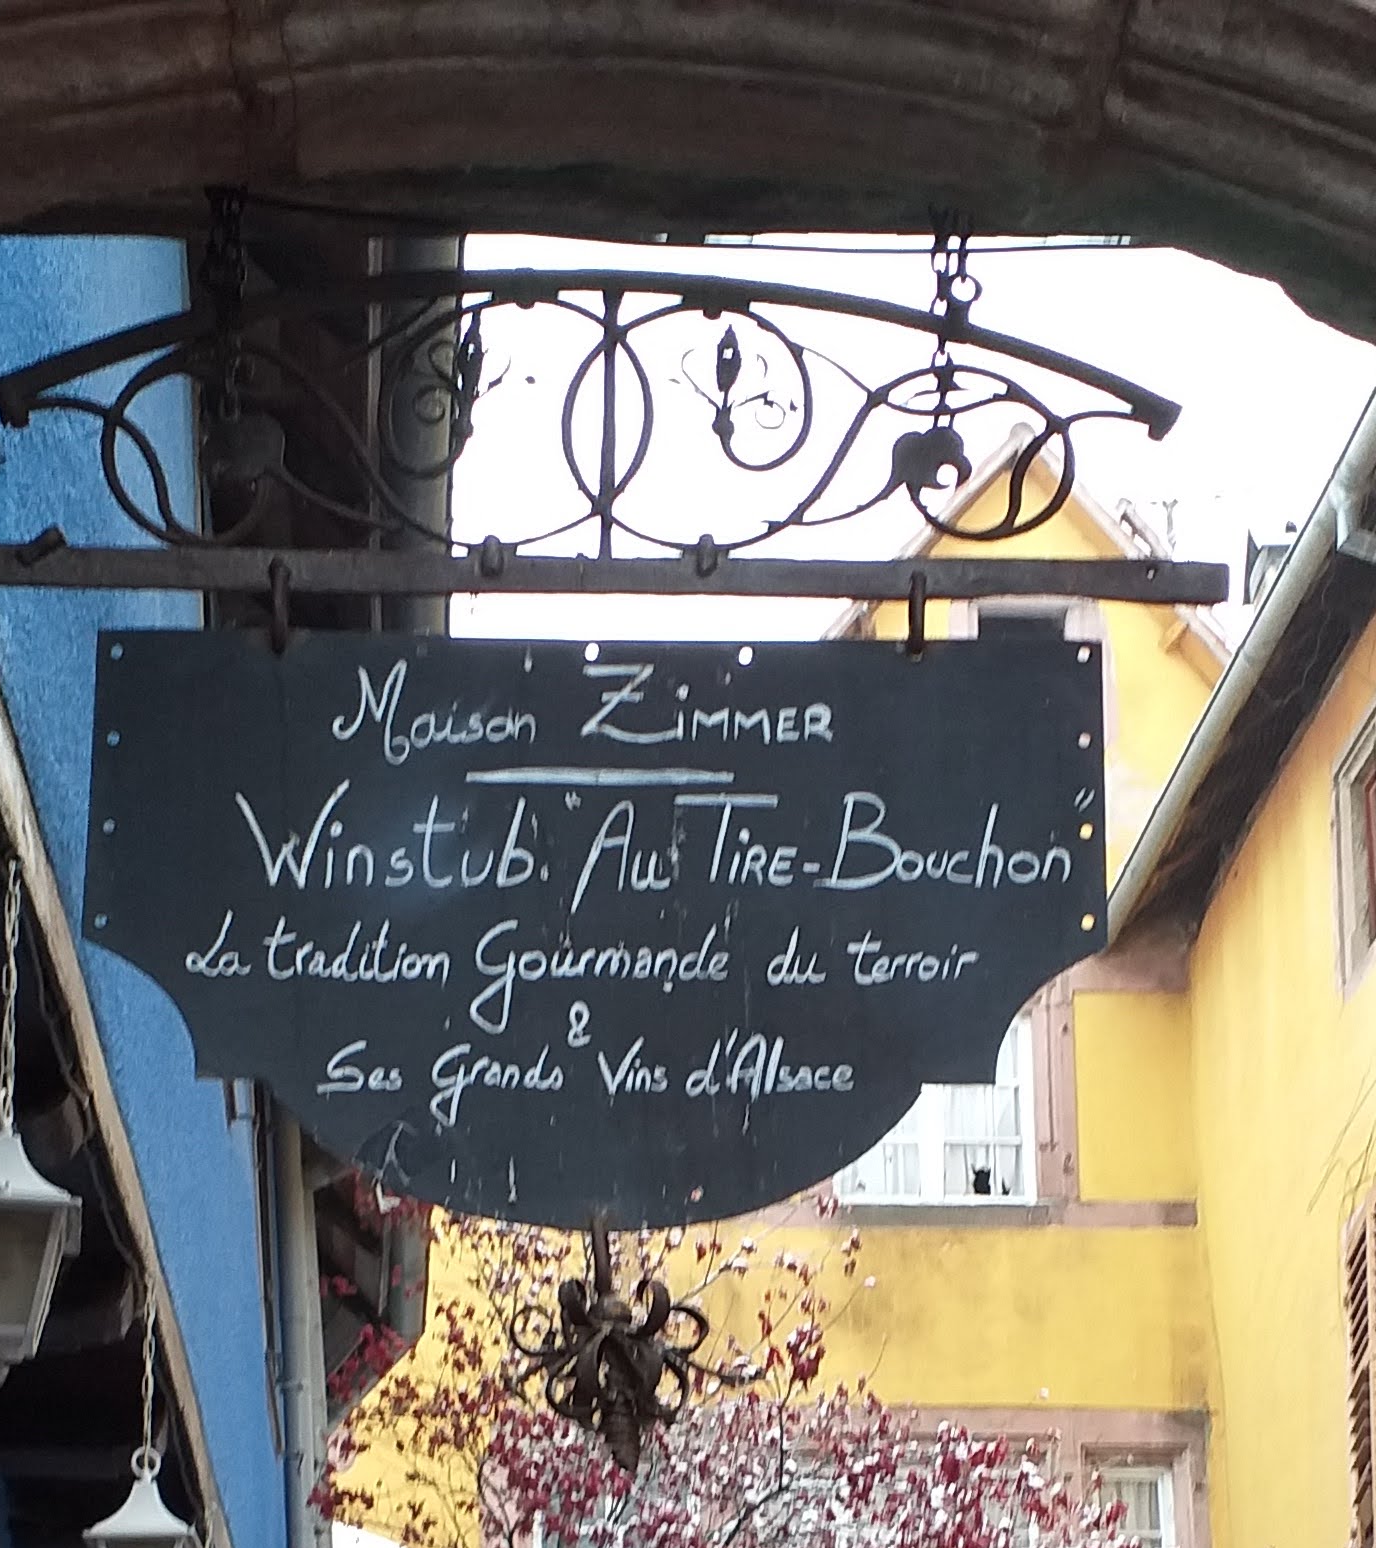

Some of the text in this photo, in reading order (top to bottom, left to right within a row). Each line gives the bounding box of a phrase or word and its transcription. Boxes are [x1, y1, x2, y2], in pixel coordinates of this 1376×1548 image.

[332, 659, 536, 765] Maison
[185, 909, 251, 977] La
[262, 915, 450, 990] tradition
[766, 926, 827, 986] du
[846, 930, 980, 986] terroir
[567, 1000, 592, 1048] &
[317, 1028, 855, 1127] Ses Grands Vins d'Alsace
